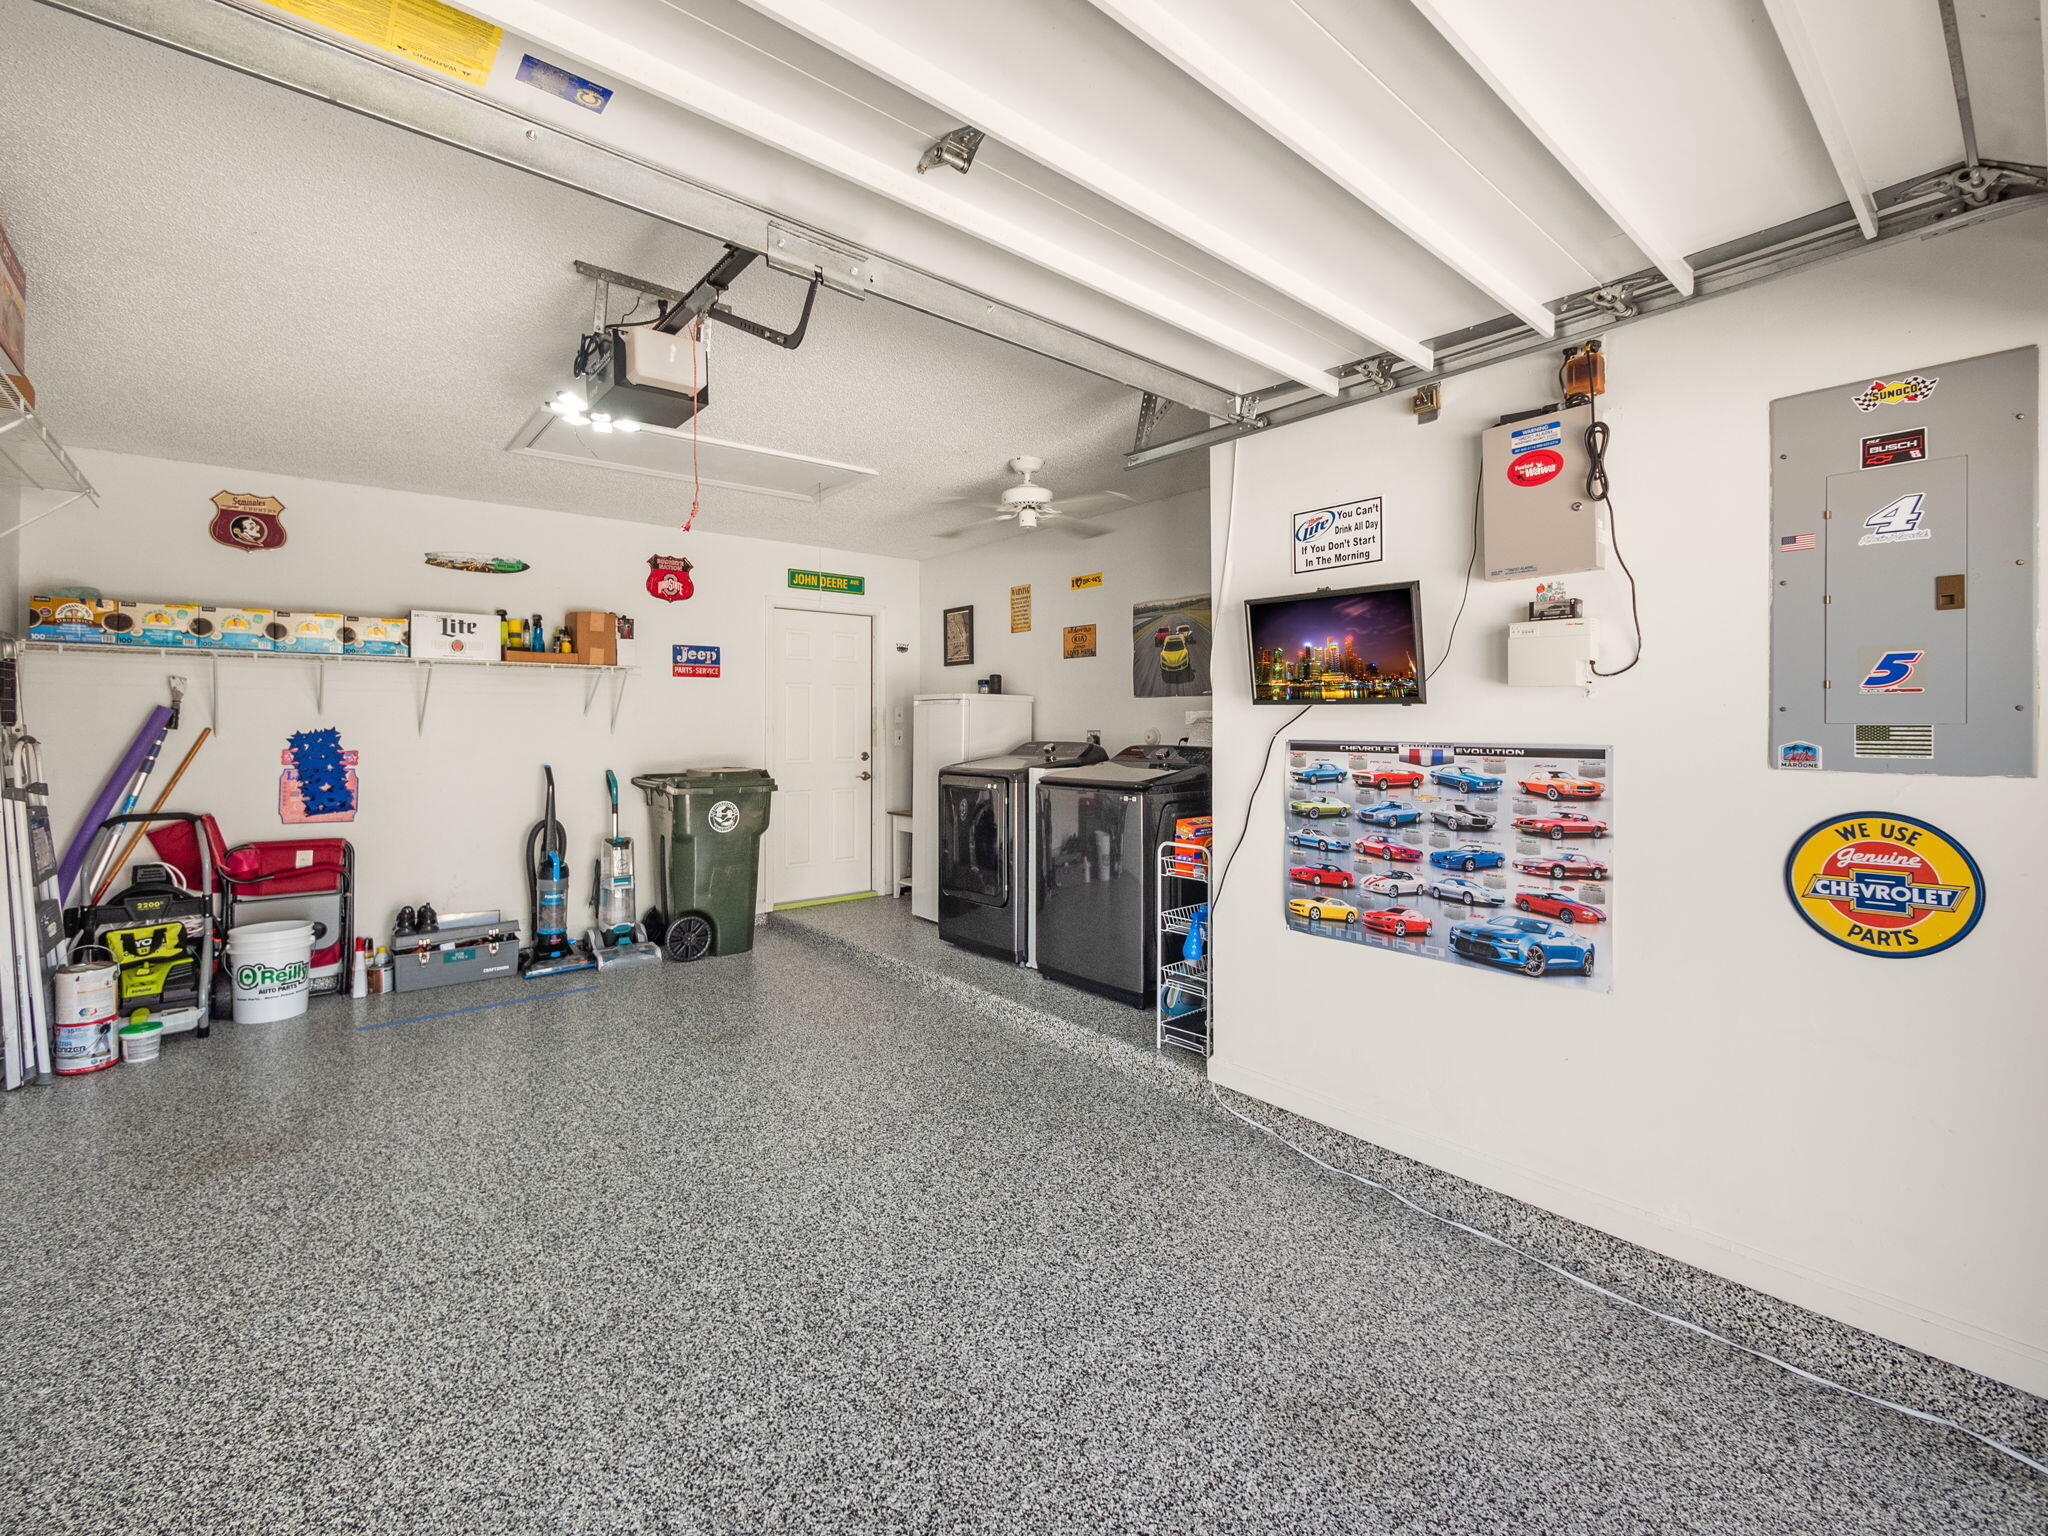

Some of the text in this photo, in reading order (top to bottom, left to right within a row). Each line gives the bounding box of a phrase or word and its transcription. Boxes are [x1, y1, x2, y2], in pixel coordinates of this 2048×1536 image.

[412, 51, 458, 73] WARNING
[1871, 383, 1919, 401] SUNOCO
[1869, 440, 1918, 454] BUSCH
[1909, 449, 1922, 458] 8
[1525, 464, 1557, 478] Wawa
[232, 497, 266, 507] Seminoles
[1337, 503, 1379, 520] You Can't
[1865, 493, 1924, 535] 4
[1302, 518, 1330, 542] Lite
[1335, 520, 1379, 535] Drink All Day
[1301, 535, 1376, 555] If You Don't Start
[1305, 550, 1370, 567] In The Morning
[792, 573, 818, 586] JOHN
[820, 575, 848, 589] DEERE
[441, 617, 477, 637] Lite
[676, 647, 717, 664] Jeep
[1861, 652, 1924, 689] 5
[1340, 745, 1396, 753] CHEVROLET
[1455, 747, 1525, 756] EVOLUTION
[1834, 823, 1923, 847] WE USE
[1836, 848, 1922, 868] Genuine
[1815, 880, 1952, 906] CHEVROLET
[137, 901, 160, 909] 2200
[1847, 924, 1920, 947] PARTS
[239, 963, 309, 987] O'Reilly
[259, 987, 276, 995] AUTO
[278, 983, 298, 992] PARTS
